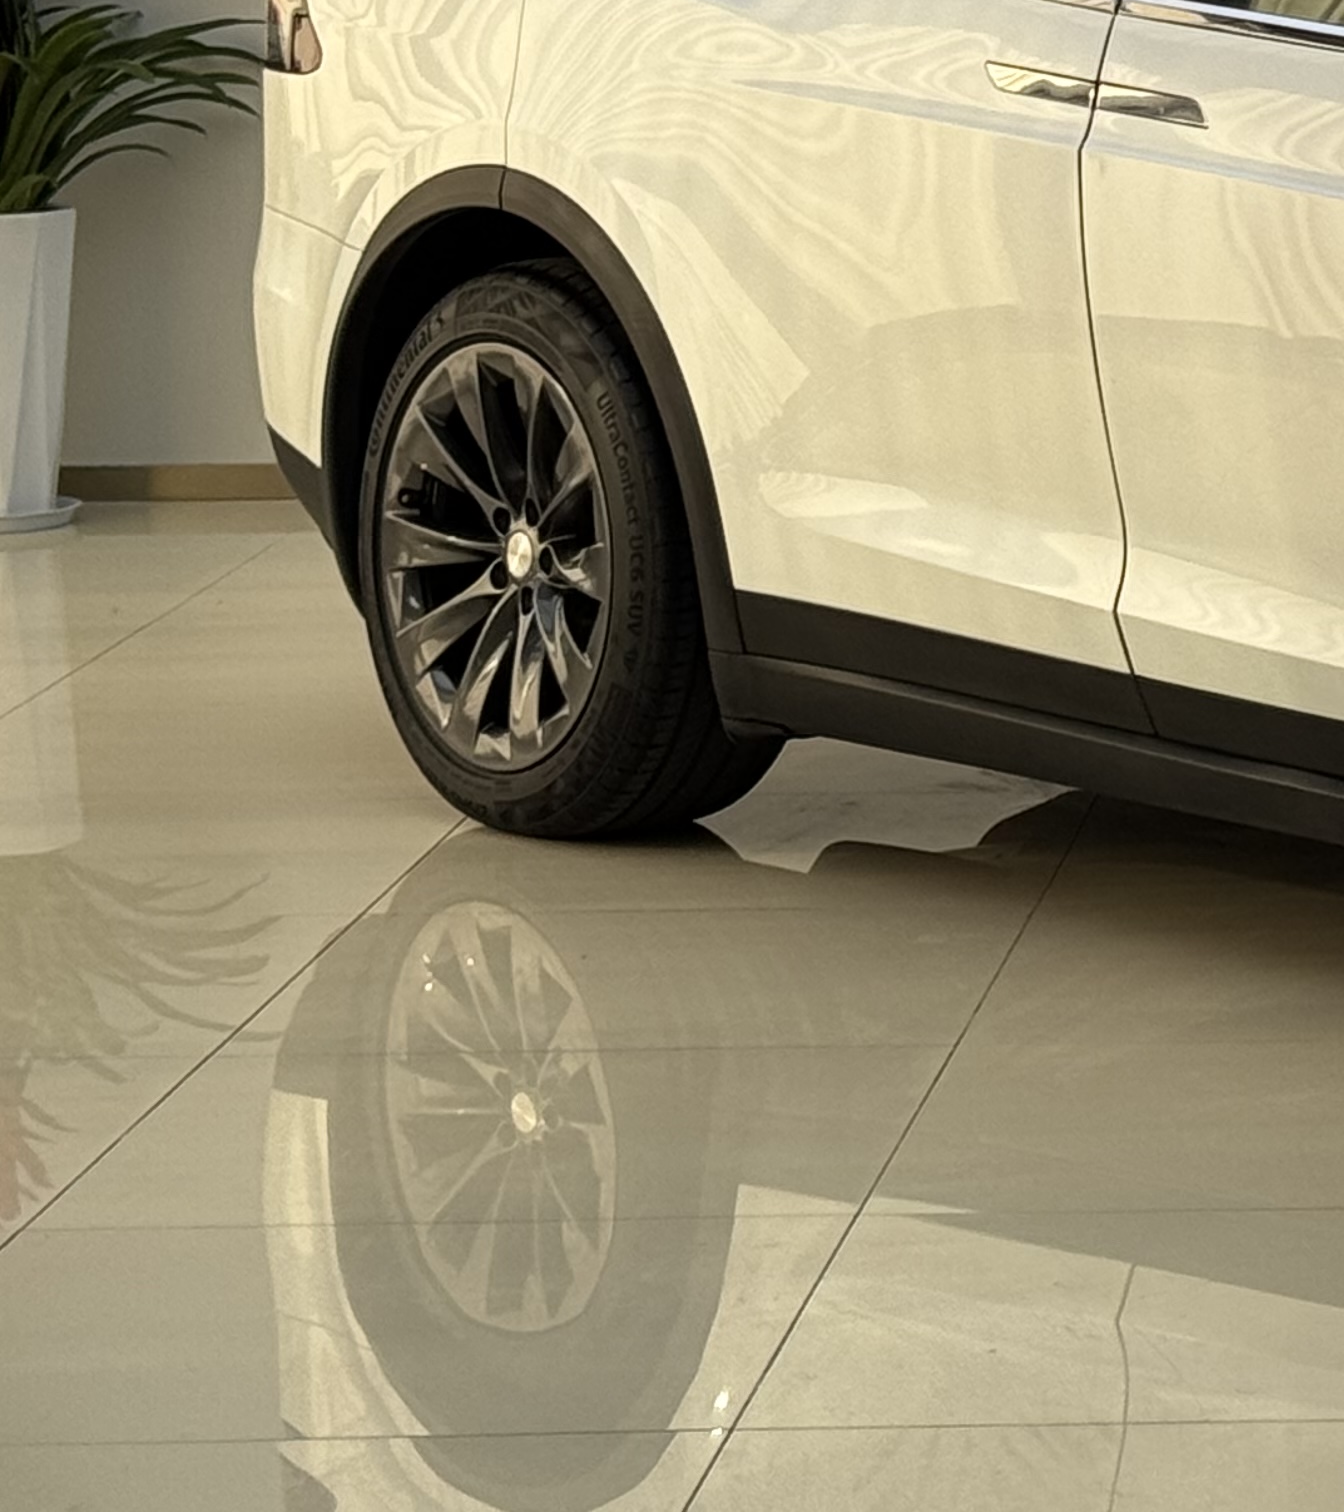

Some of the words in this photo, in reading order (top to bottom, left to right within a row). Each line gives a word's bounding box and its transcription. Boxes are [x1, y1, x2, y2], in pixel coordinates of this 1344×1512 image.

[597, 391, 640, 525] UltraContact
[628, 534, 644, 581] UC6
[627, 589, 644, 637] SUV
